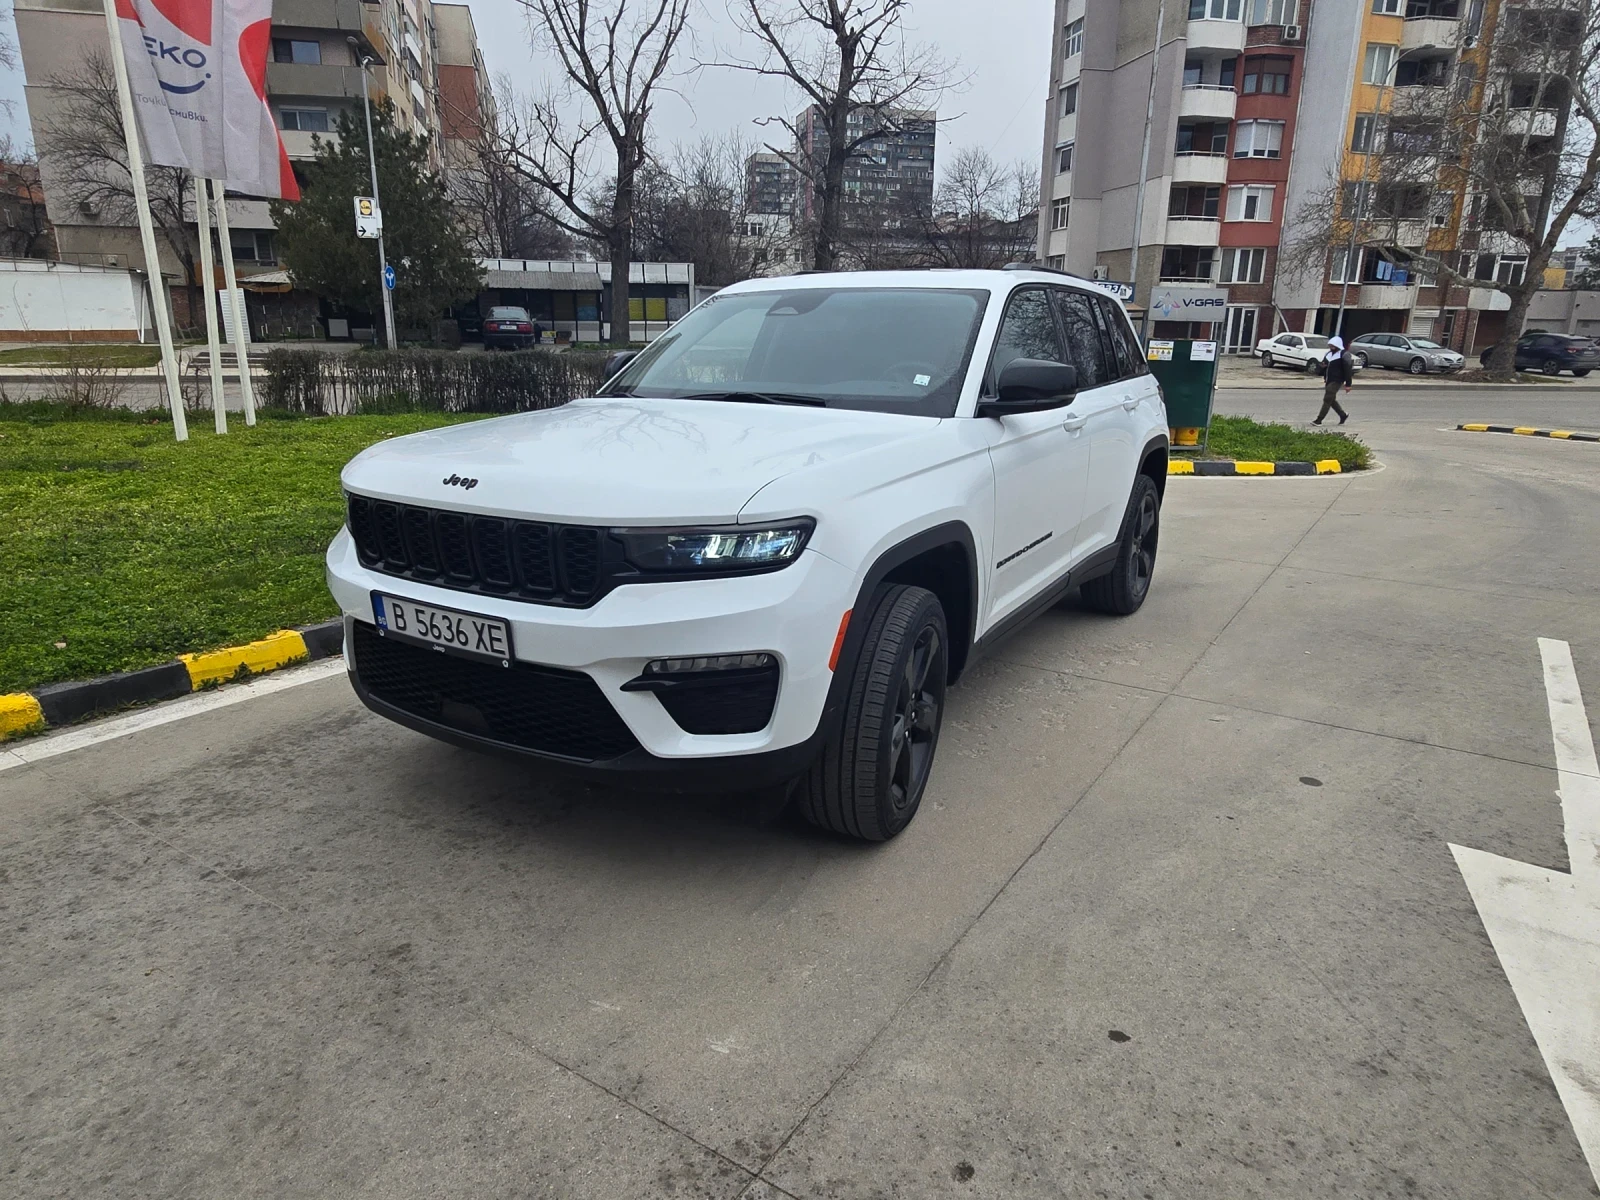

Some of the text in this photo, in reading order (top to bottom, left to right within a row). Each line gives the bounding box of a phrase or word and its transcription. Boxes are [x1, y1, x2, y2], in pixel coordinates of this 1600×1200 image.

[142, 35, 207, 68] EKO
[169, 108, 208, 122] смивки.
[442, 473, 479, 491] Jeep
[391, 602, 506, 656] B 5636 XE
